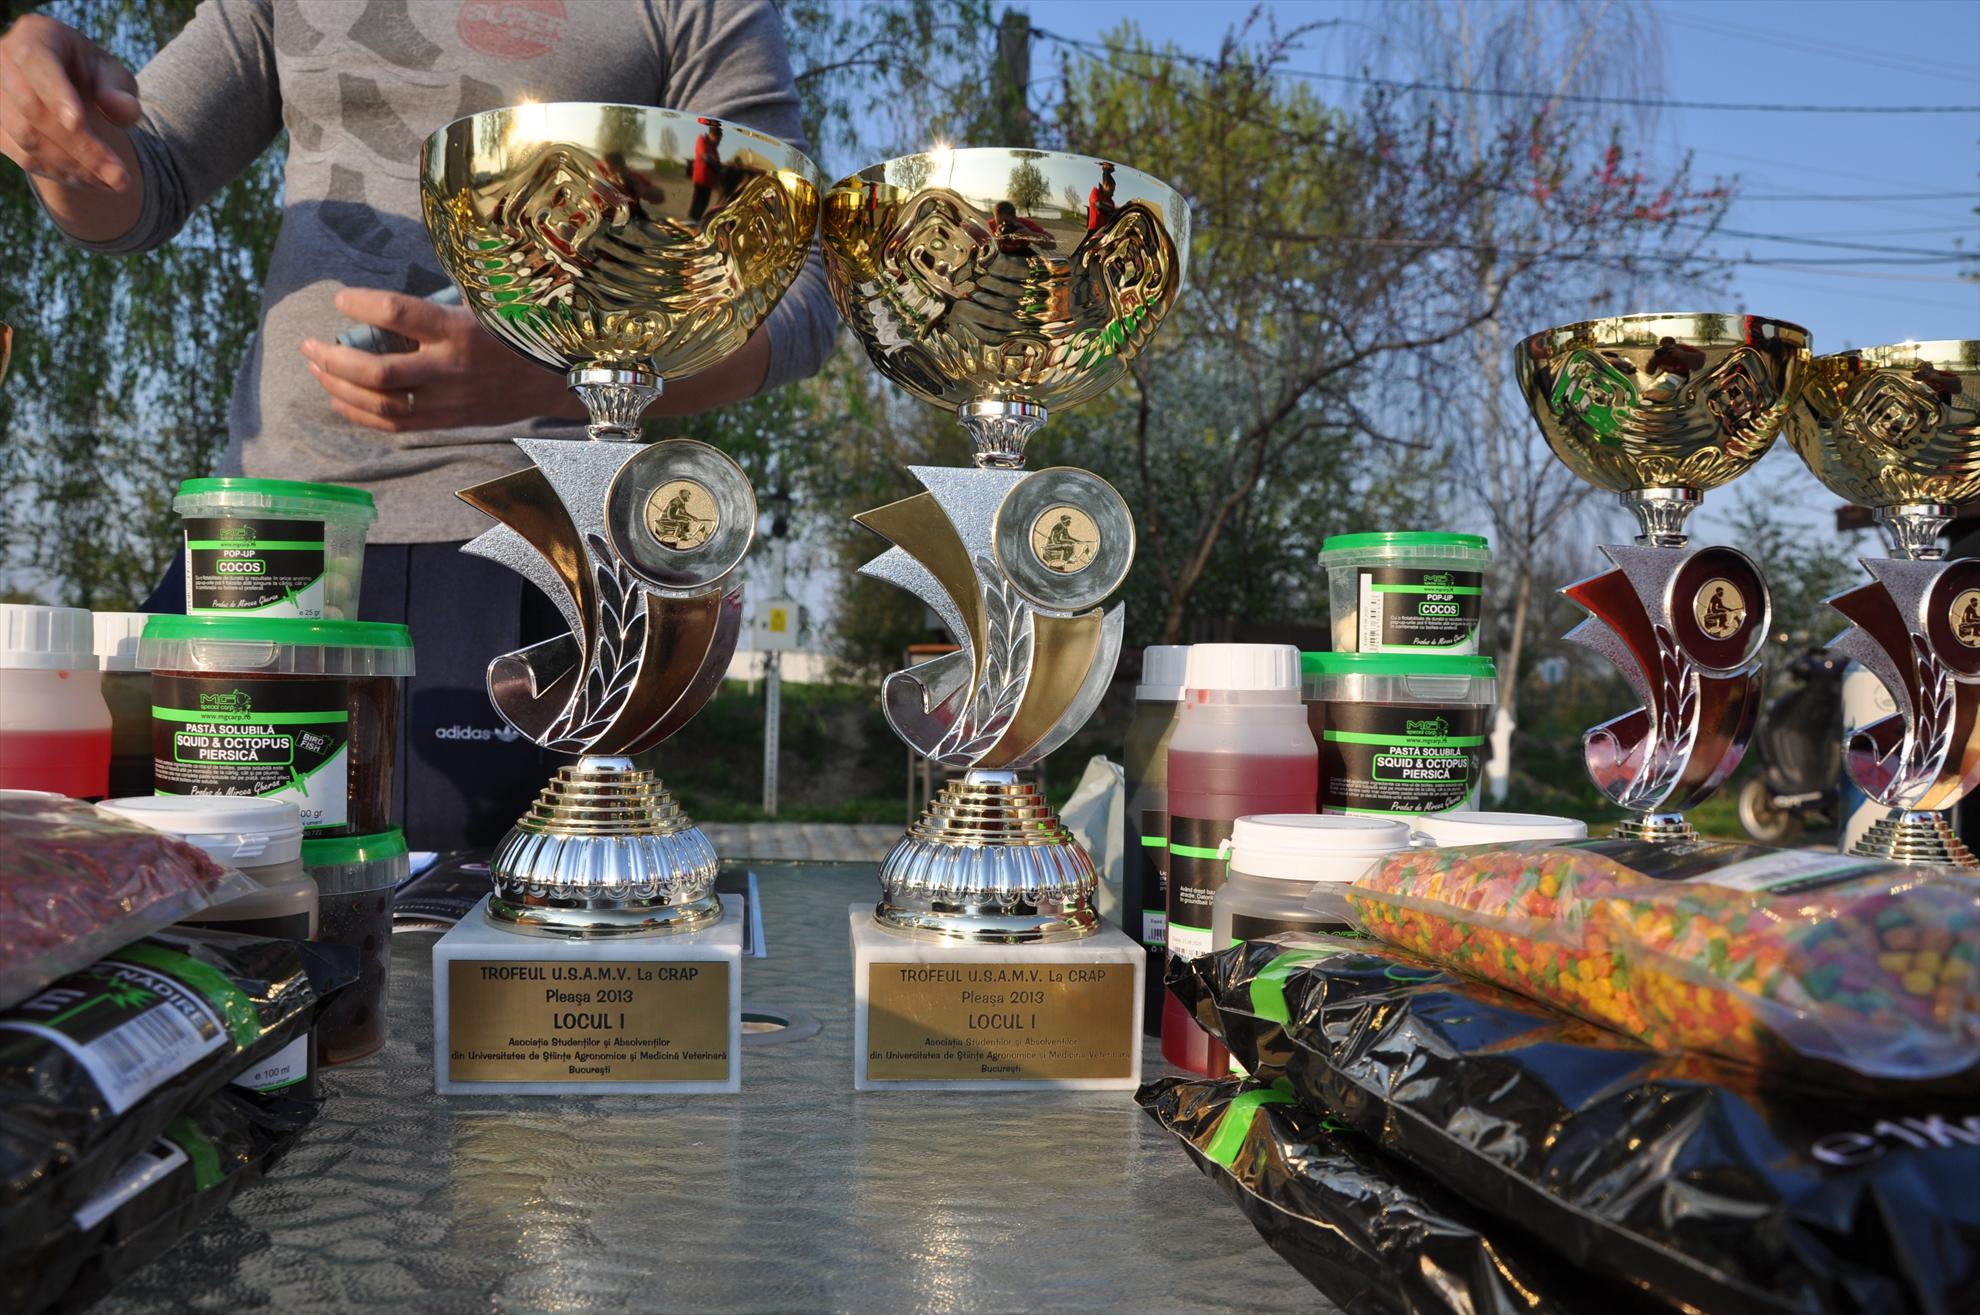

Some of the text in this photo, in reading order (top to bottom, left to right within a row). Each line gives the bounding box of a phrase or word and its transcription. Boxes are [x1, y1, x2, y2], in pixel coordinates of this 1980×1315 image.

[223, 550, 256, 558] POP-UP
[219, 562, 261, 573] COCOS
[1423, 604, 1457, 614] COCOS
[186, 722, 275, 735] PASTĂ SOLUBILĂ
[435, 725, 491, 740] adidas
[177, 735, 290, 750] SQUID & OCTOPUS
[302, 733, 324, 746] BIRD
[300, 740, 321, 753] FISH
[1389, 746, 1462, 757] PASTĂ SOLUBILĂ
[199, 748, 259, 761] PIERSICĂ
[1376, 757, 1413, 769] SQUID
[1415, 759, 1424, 768] &
[1426, 758, 1468, 769] OCTOPUS
[1402, 767, 1451, 780] PIERSICĂ
[313, 809, 323, 819] gr
[480, 966, 699, 982] TROFEUL U.S.A.M.V. La CRAP
[900, 969, 1107, 983] TROFEUL U.S.A.M.V. La CRAP
[596, 989, 634, 1004] 2013
[1009, 991, 1045, 1004] 2013
[553, 1013, 626, 1030] LOCUL I
[968, 1013, 1036, 1030] LOCUL I
[451, 1051, 466, 1061] din
[468, 1051, 527, 1061] Universitatea
[529, 1051, 541, 1061] de
[574, 1051, 627, 1063] Agronomice
[869, 1050, 884, 1060] din
[885, 1050, 941, 1060] Universitatea
[943, 1050, 955, 1060] de
[986, 1050, 1037, 1062] Agronomice
[264, 1067, 280, 1078] 100
[281, 1064, 290, 1073] ml
